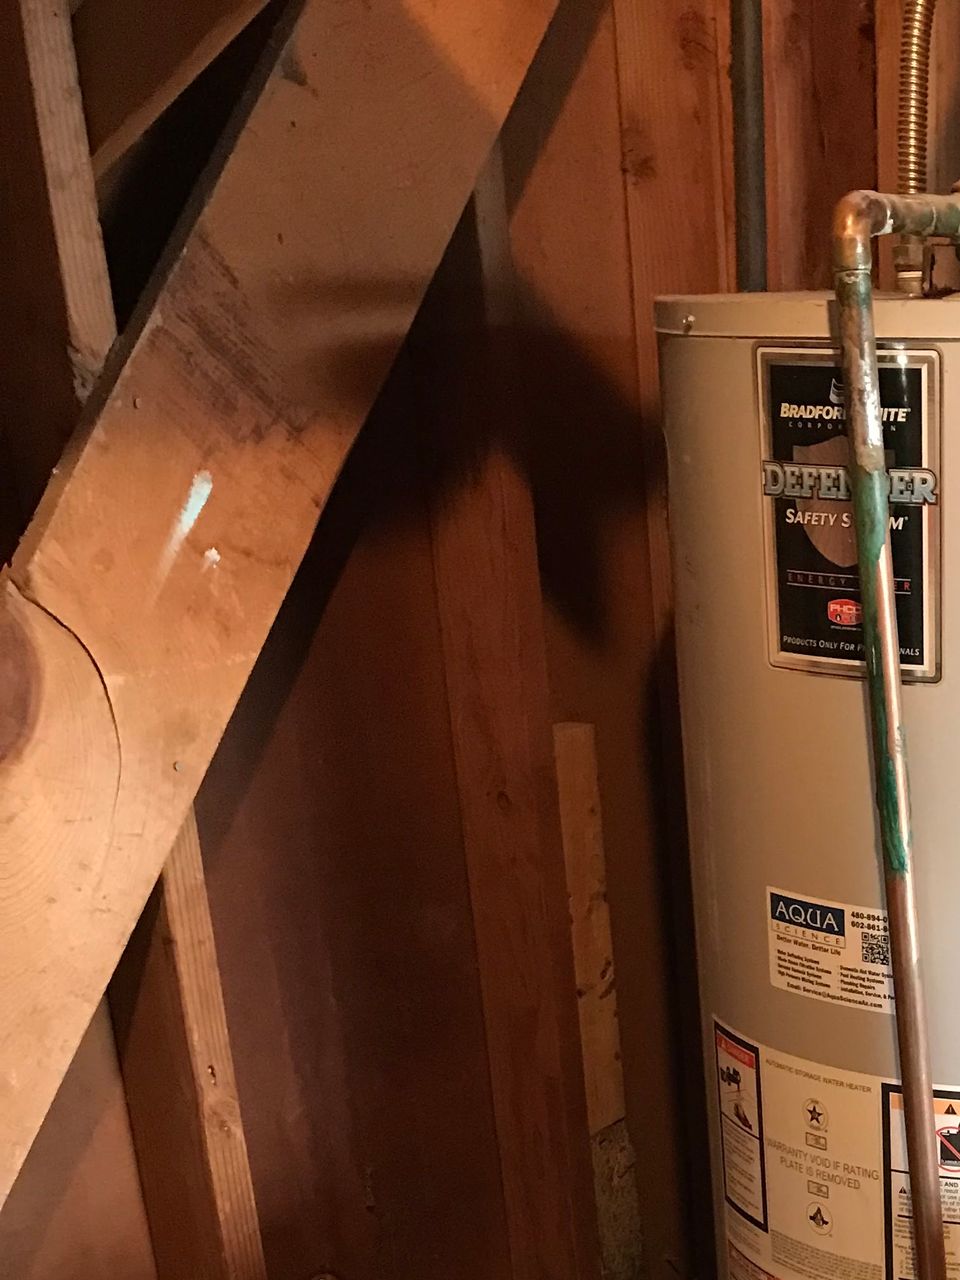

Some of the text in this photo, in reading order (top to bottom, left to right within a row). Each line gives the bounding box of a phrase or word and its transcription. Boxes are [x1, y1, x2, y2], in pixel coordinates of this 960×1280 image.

[780, 402, 908, 422] BRADFOR ITE
[764, 461, 937, 505] DEFEER
[785, 509, 837, 526] SAFETY
[783, 635, 817, 647] PRODUCTS
[818, 639, 838, 650] ONLY
[839, 642, 855, 651] FOR
[775, 901, 839, 932] AQUA
[851, 911, 888, 923] 480-894-0
[776, 923, 841, 944] SCIENCE
[780, 1156, 861, 1190] PLATE IS REMOVED
[810, 1155, 831, 1168] VOID
[833, 1161, 841, 1170] IF
[843, 1163, 880, 1180] RATING
